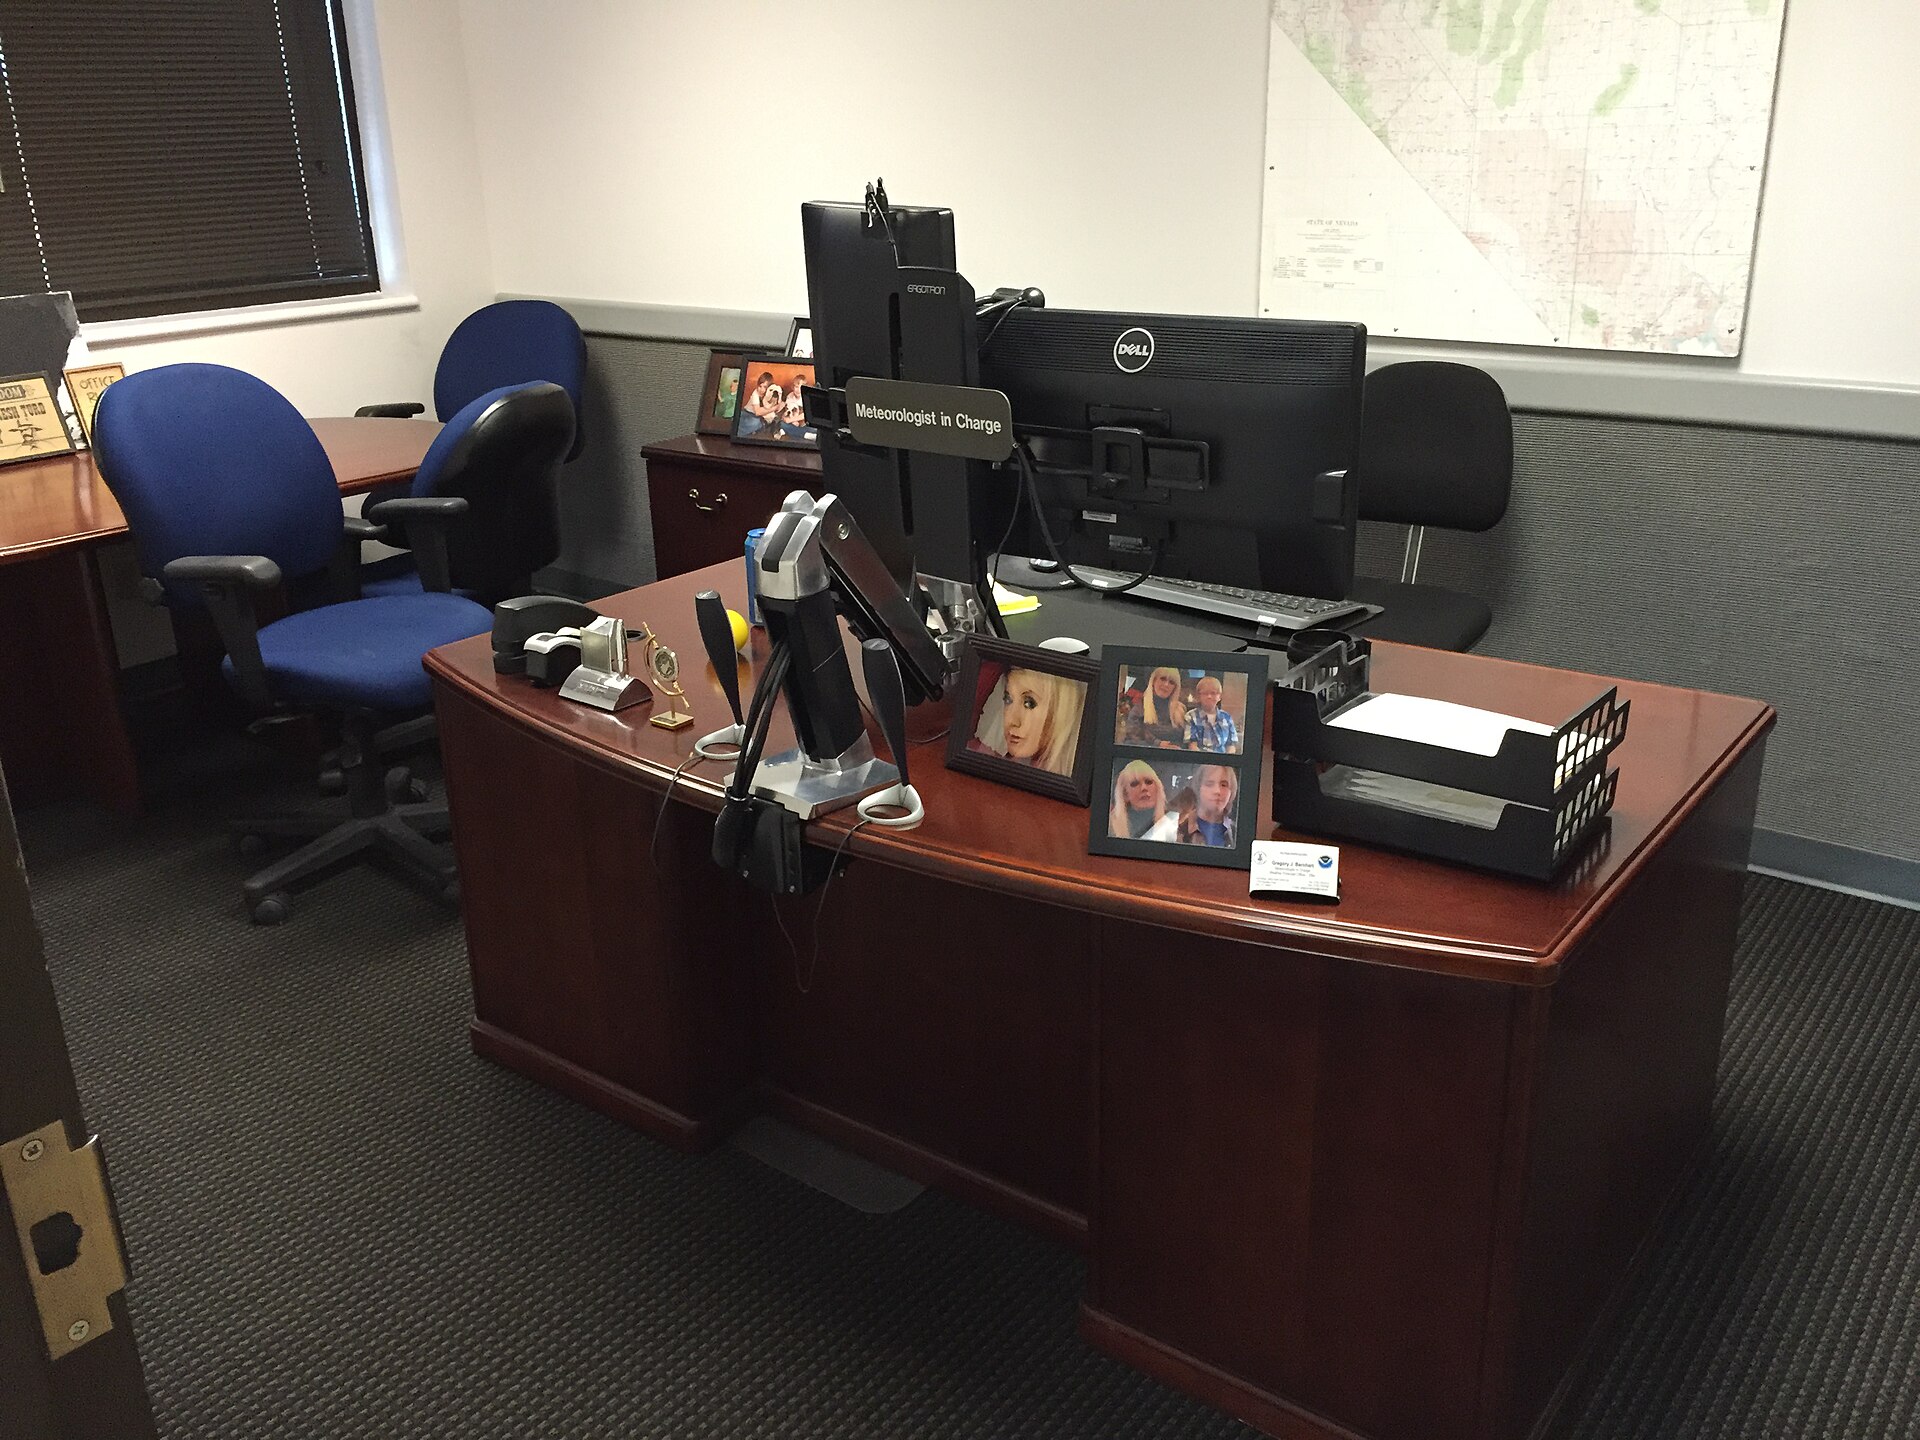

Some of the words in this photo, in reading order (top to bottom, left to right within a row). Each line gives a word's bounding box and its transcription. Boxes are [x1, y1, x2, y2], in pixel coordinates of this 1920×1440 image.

[1118, 343, 1150, 356] DELL
[79, 375, 115, 390] OFFICE
[855, 402, 937, 427] Meteorologist
[940, 411, 952, 427] in
[955, 412, 1002, 435] Charge
